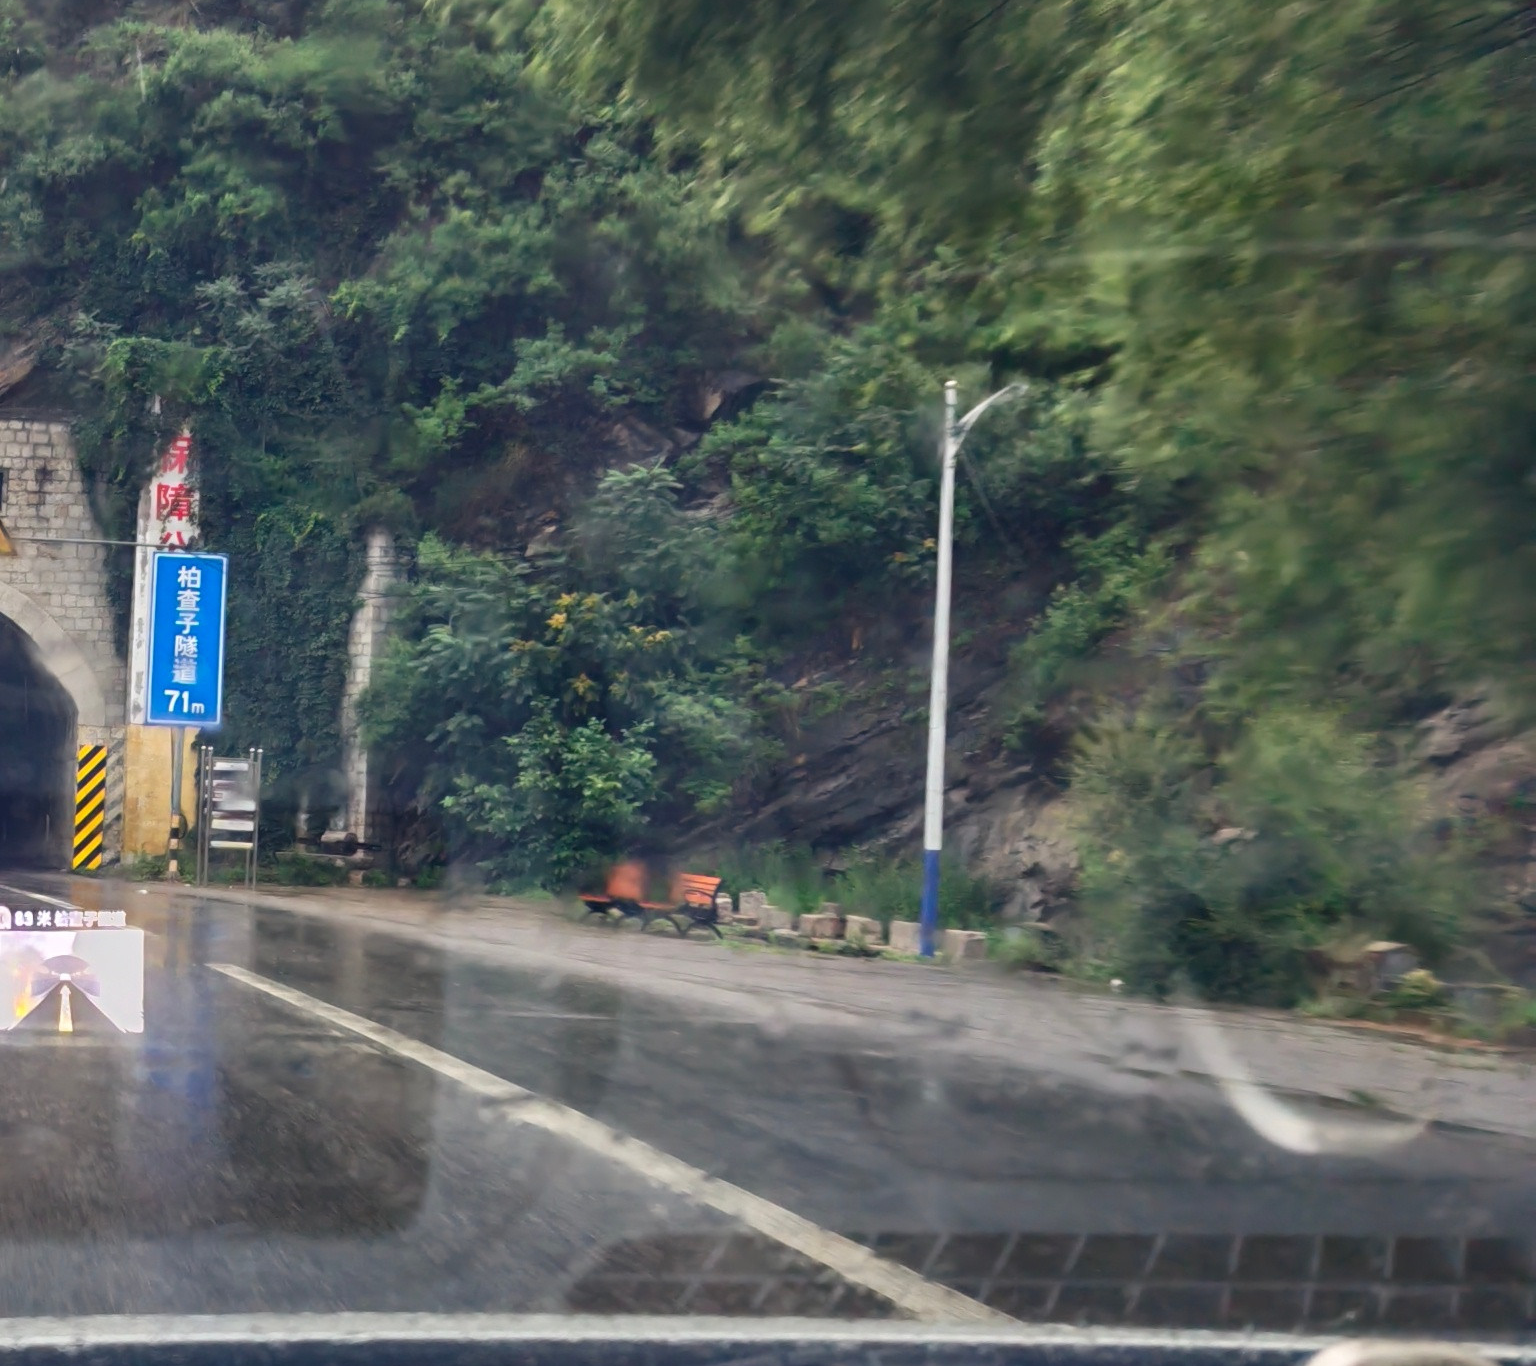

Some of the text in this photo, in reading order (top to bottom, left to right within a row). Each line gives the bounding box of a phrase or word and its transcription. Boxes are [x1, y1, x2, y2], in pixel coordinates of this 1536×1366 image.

[172, 565, 202, 684] 柏查子隧道
[164, 689, 205, 714] 71m
